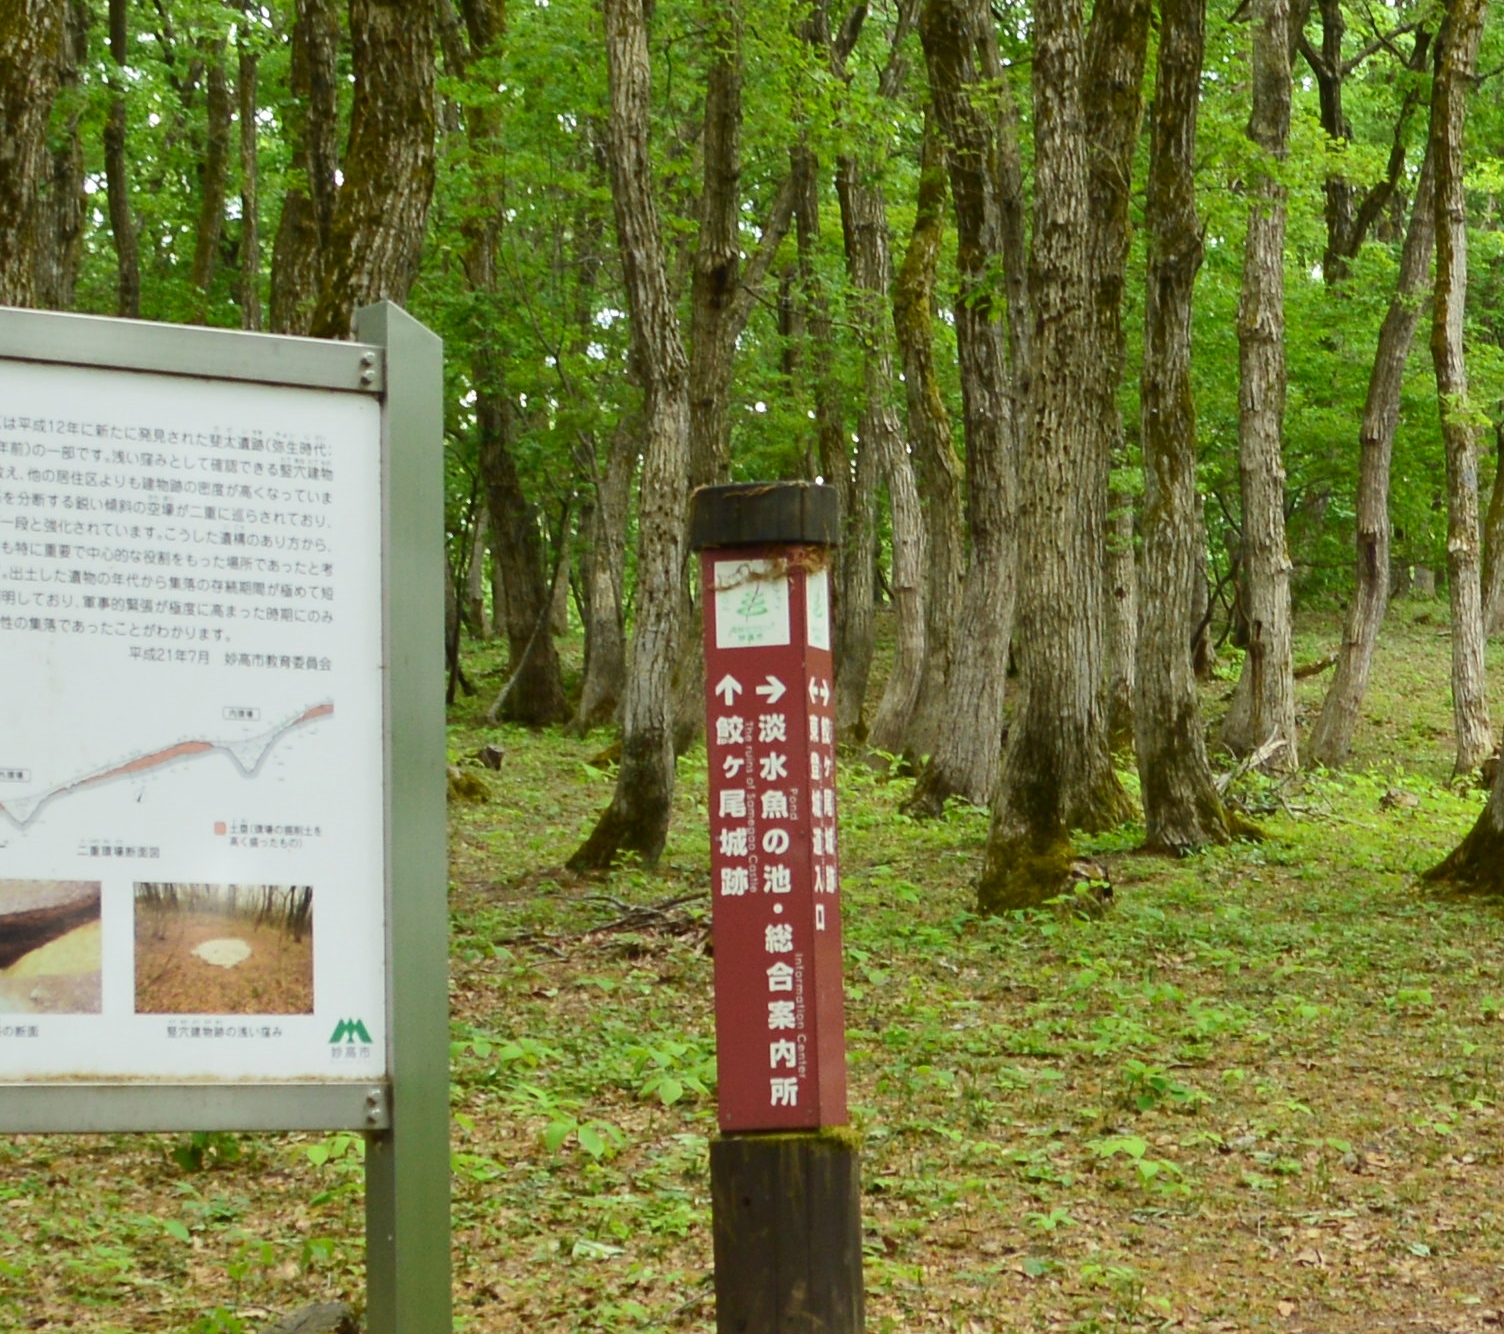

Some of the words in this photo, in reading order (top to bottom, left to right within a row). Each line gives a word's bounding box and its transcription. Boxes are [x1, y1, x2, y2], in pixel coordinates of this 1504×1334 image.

[789, 788, 798, 821] Pond
[795, 953, 805, 1029] Information
[797, 1034, 807, 1078] Center
